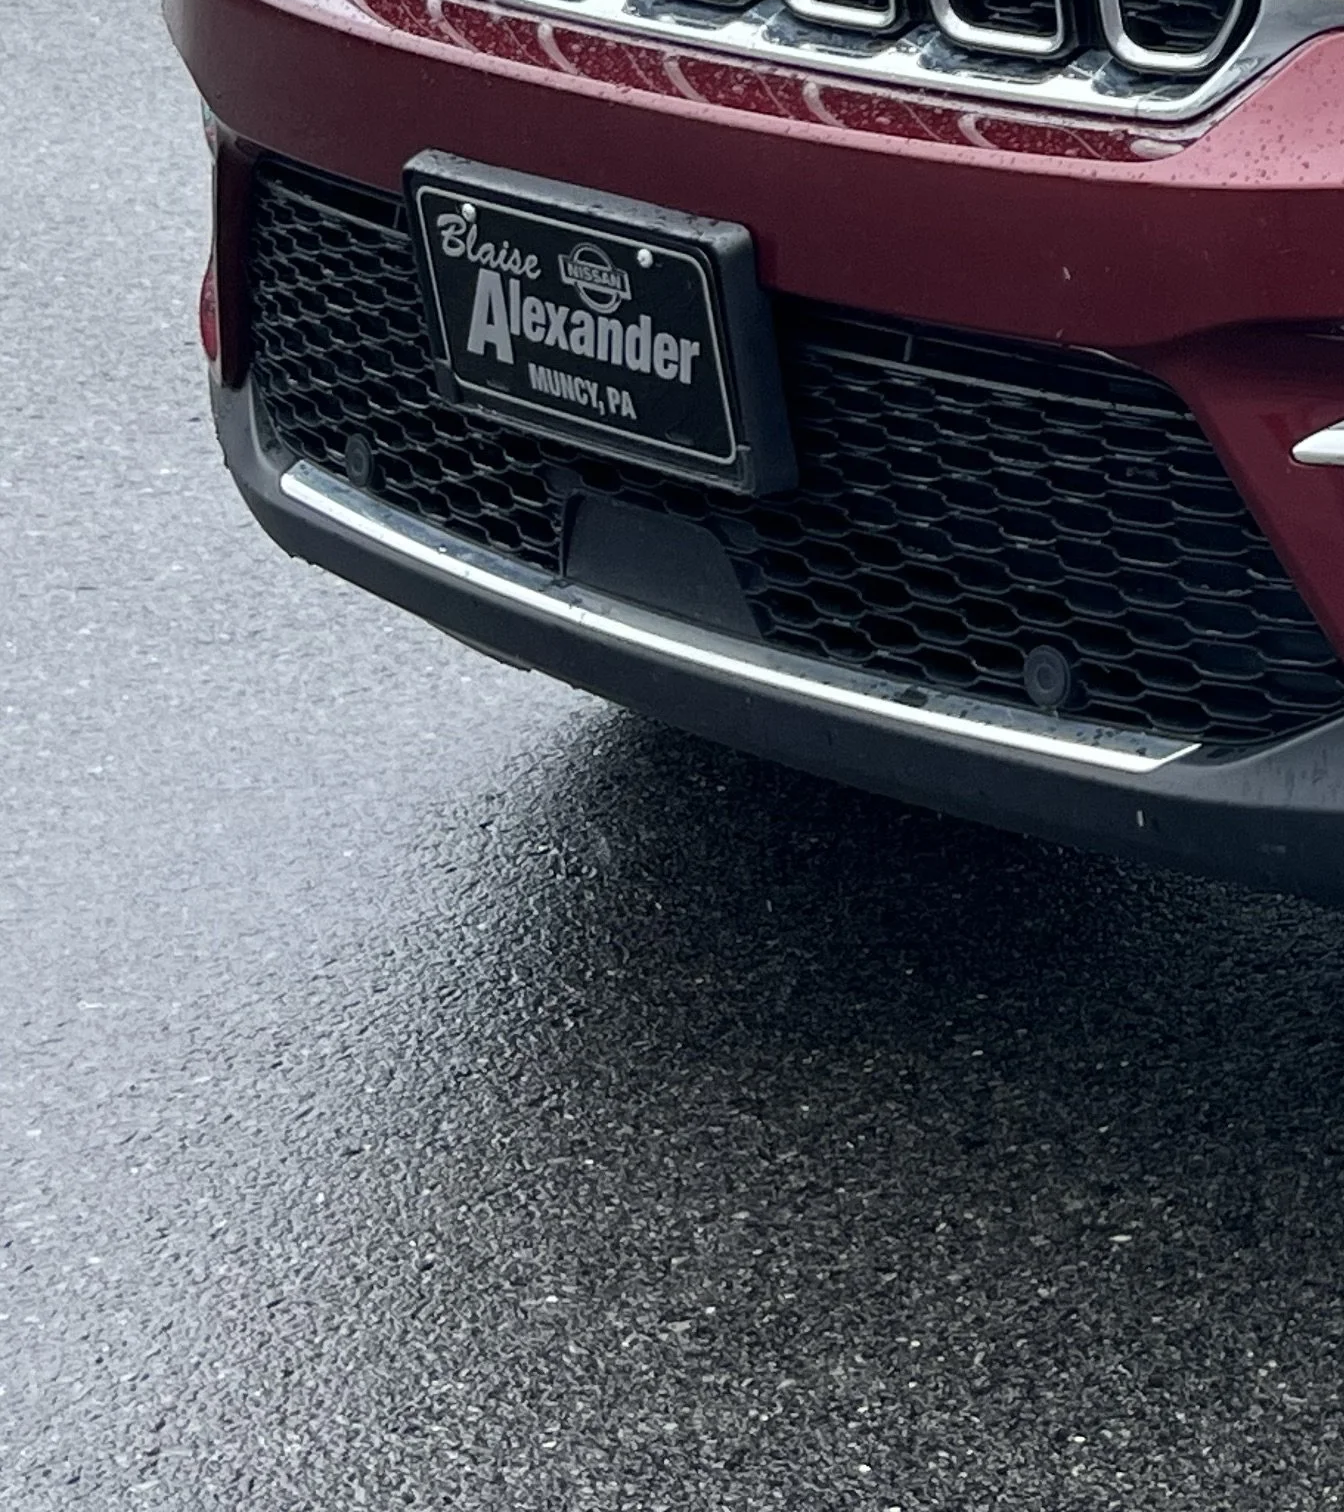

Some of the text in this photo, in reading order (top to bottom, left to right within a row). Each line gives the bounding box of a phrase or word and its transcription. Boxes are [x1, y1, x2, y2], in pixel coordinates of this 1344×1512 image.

[436, 212, 542, 280] Blaise
[566, 259, 623, 289] NISSAN
[466, 268, 700, 385] Alexander
[527, 362, 638, 421] MUNCY, PA
